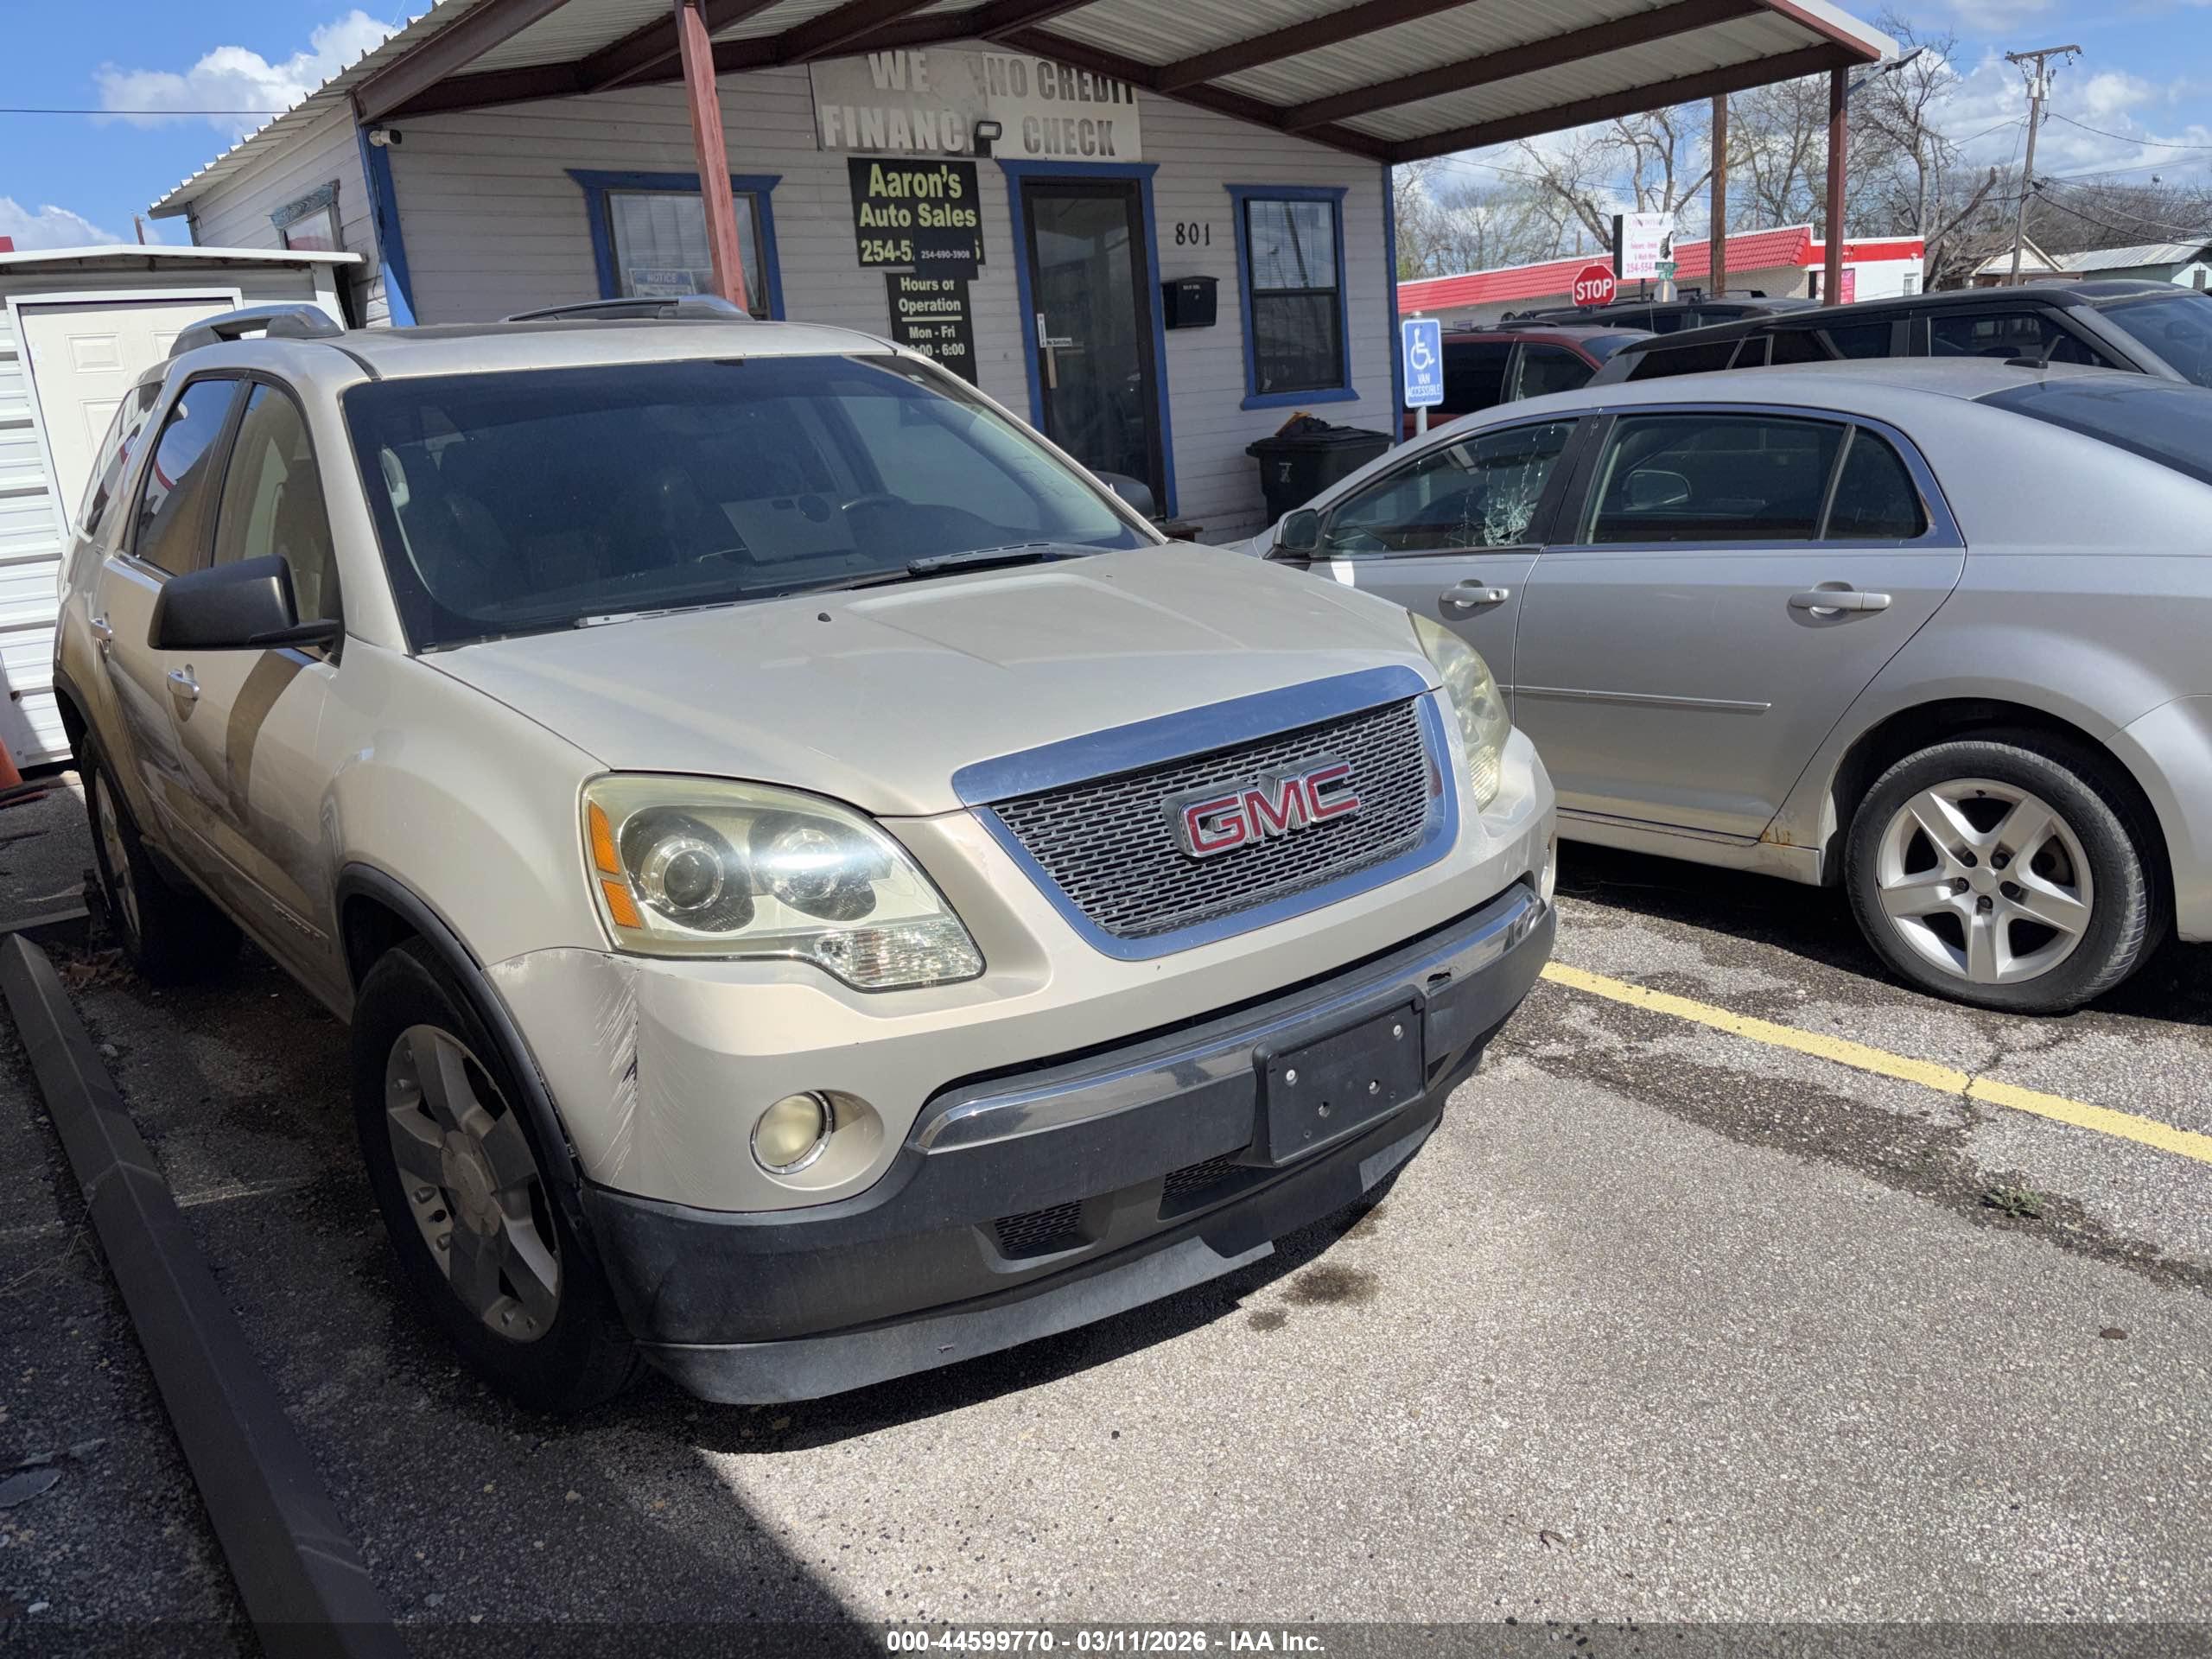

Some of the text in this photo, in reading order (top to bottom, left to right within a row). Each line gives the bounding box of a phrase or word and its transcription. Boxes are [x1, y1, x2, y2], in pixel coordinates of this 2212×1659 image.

[868, 48, 930, 92] WE
[988, 57, 1027, 99] NO
[1023, 116, 1116, 156] CHECK
[868, 163, 962, 199] Aaron's
[859, 202, 977, 227] Auto Sales
[1175, 222, 1211, 246] 801
[900, 276, 939, 291] Hours
[1576, 281, 1613, 302] STOP
[898, 297, 962, 315] Operation
[909, 326, 933, 340] Mon
[941, 325, 956, 339] Fri
[942, 343, 965, 356] 6:00
[1417, 372, 1431, 385] VAN
[1408, 384, 1441, 397] ACCESSIBLE
[1177, 759, 1362, 858] GMC
